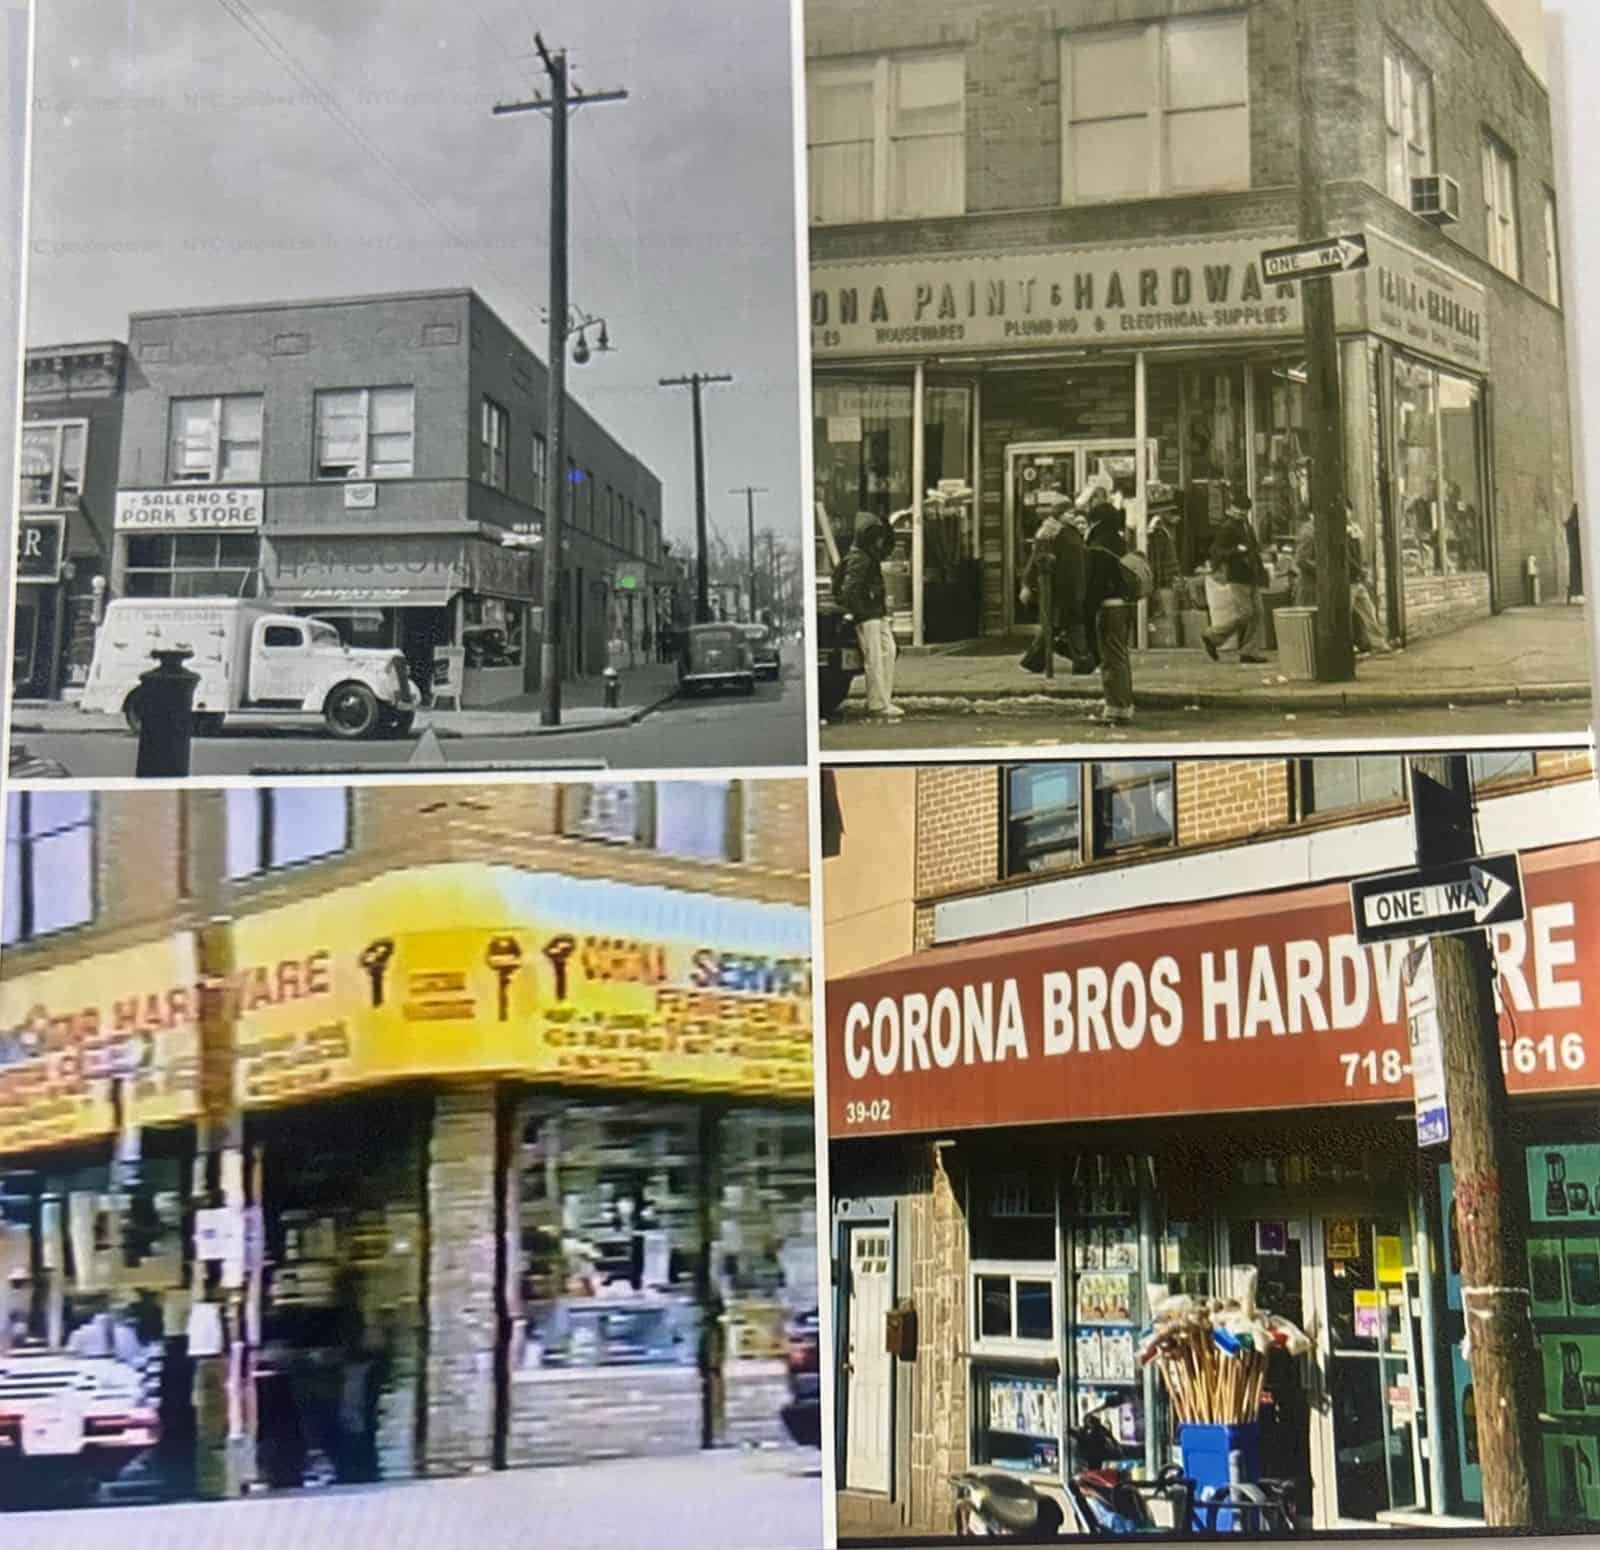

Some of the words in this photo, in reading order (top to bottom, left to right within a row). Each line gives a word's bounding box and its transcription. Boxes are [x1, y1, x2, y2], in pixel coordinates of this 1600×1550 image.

[1269, 256, 1297, 271] ONE
[1320, 246, 1350, 264] WAY
[915, 278, 1036, 320] PAINT
[1120, 311, 1207, 330] ELECTRICAL
[1213, 306, 1288, 326] SUPPLIES
[122, 508, 176, 524] PORK
[188, 506, 256, 523] STORE
[1376, 891, 1424, 921] ONE
[1444, 879, 1493, 911] WAY
[844, 978, 1029, 1080] CORONA
[1043, 955, 1184, 1057] BROS
[1200, 901, 1582, 1042] HARDWRE
[846, 1099, 891, 1123] 39-02
